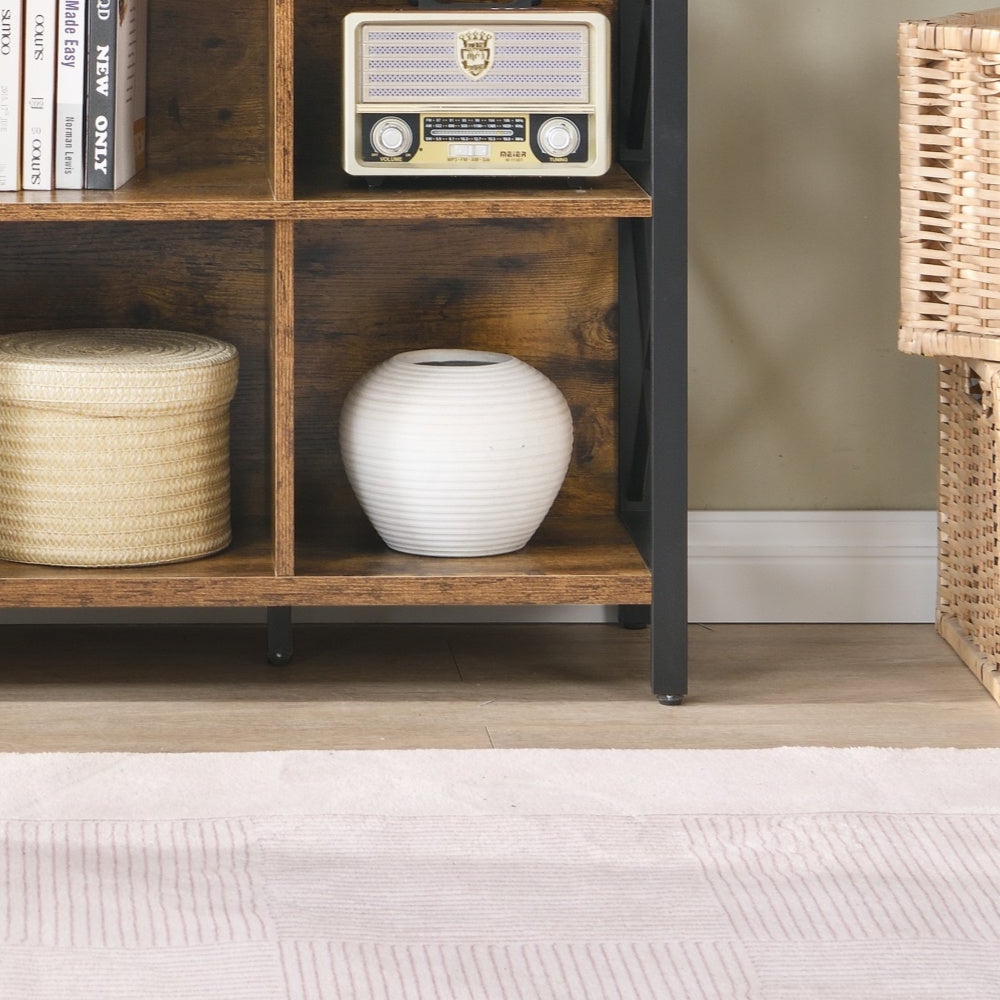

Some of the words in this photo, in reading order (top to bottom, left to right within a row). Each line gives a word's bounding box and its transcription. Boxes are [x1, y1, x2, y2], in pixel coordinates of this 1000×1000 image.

[63, 0, 80, 35] Made
[60, 39, 79, 68] Easy
[95, 45, 110, 97] NEW
[64, 116, 75, 149] Norman
[93, 115, 109, 175] ONLY
[63, 151, 75, 175] Lewis
